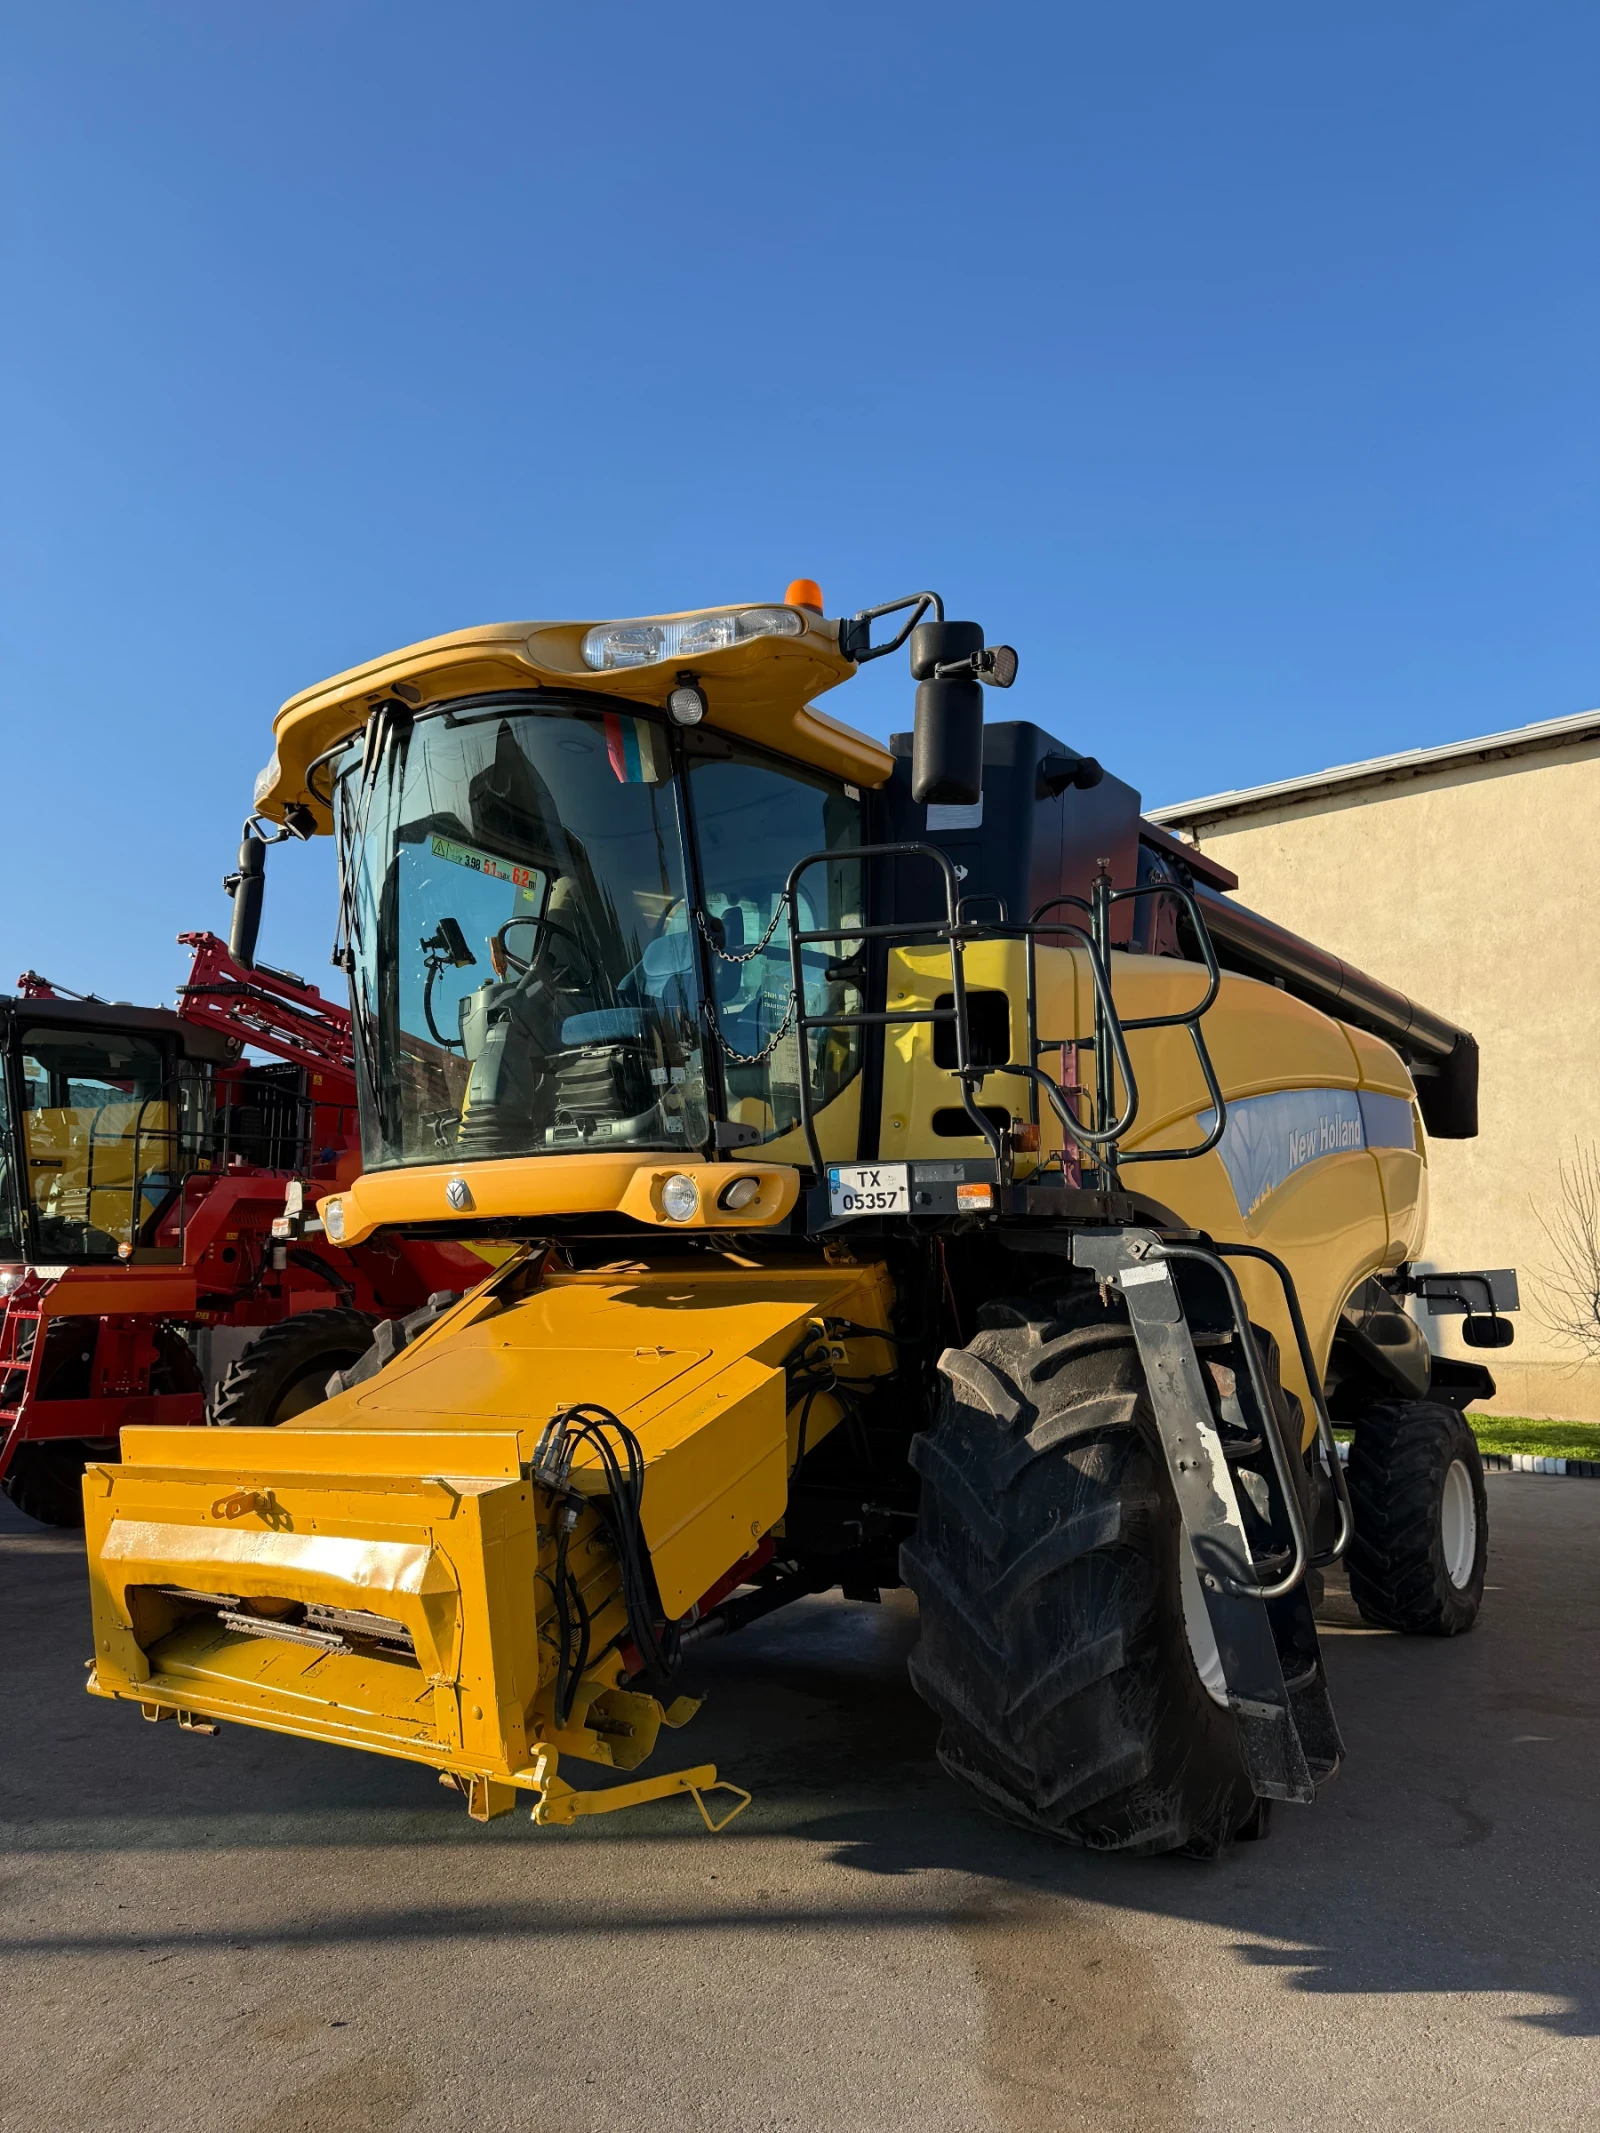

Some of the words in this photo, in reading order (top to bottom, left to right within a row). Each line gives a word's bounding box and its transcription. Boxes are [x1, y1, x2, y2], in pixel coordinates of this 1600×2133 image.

[1289, 1128, 1317, 1170] New
[1319, 1111, 1361, 1152] Holland
[857, 1171, 881, 1188] TX
[843, 1192, 897, 1210] 05357
